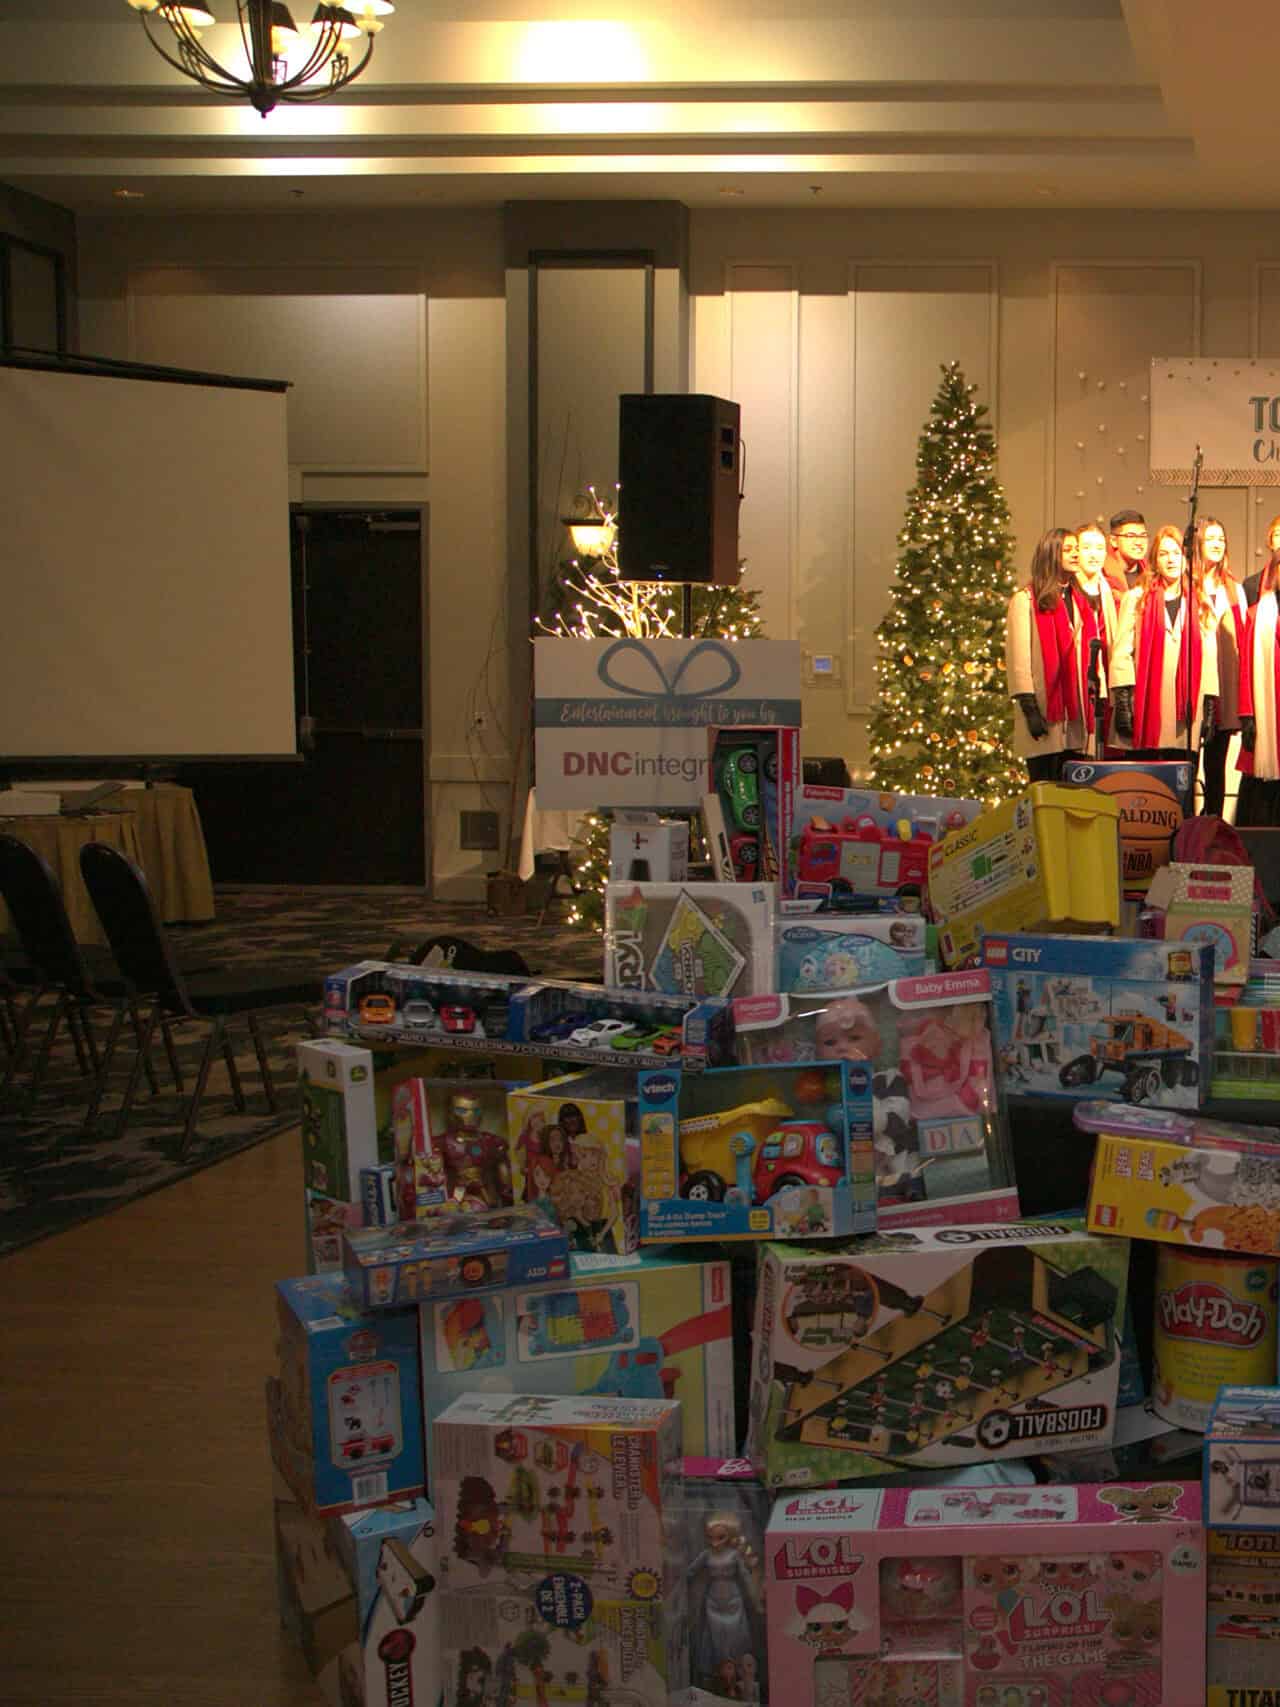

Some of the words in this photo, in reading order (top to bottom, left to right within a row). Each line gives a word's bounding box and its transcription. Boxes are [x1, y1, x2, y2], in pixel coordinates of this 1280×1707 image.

[1011, 947, 1043, 963] CITY
[915, 981, 943, 995] Baby
[944, 977, 981, 992] Emma
[1160, 1293, 1262, 1340] Play-Doh
[1014, 1407, 1102, 1437] FOOSBALL
[1022, 1654, 1056, 1668] THE
